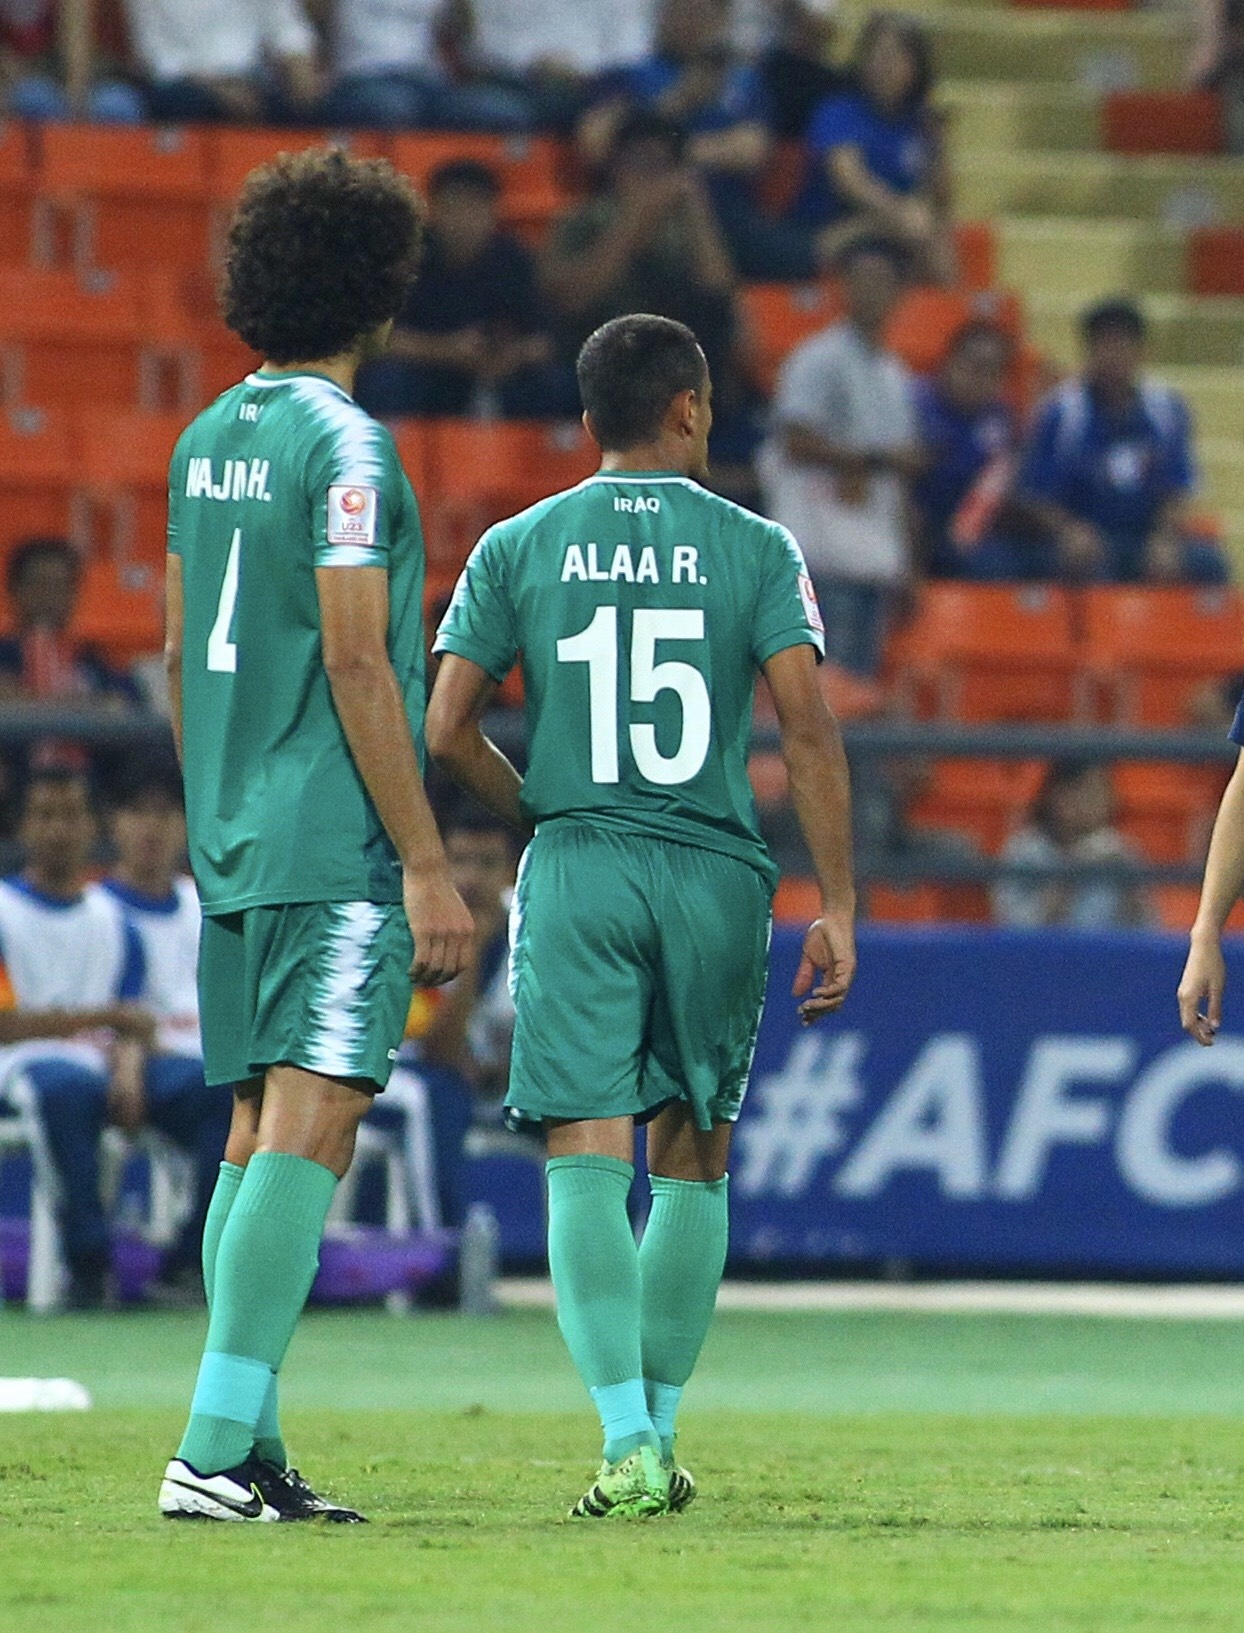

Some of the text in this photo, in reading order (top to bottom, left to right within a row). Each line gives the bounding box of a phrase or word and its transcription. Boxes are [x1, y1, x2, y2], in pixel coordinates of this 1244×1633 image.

[613, 496, 660, 513] IRAQ
[561, 542, 707, 585] ALAA R.
[556, 606, 711, 785] 15
